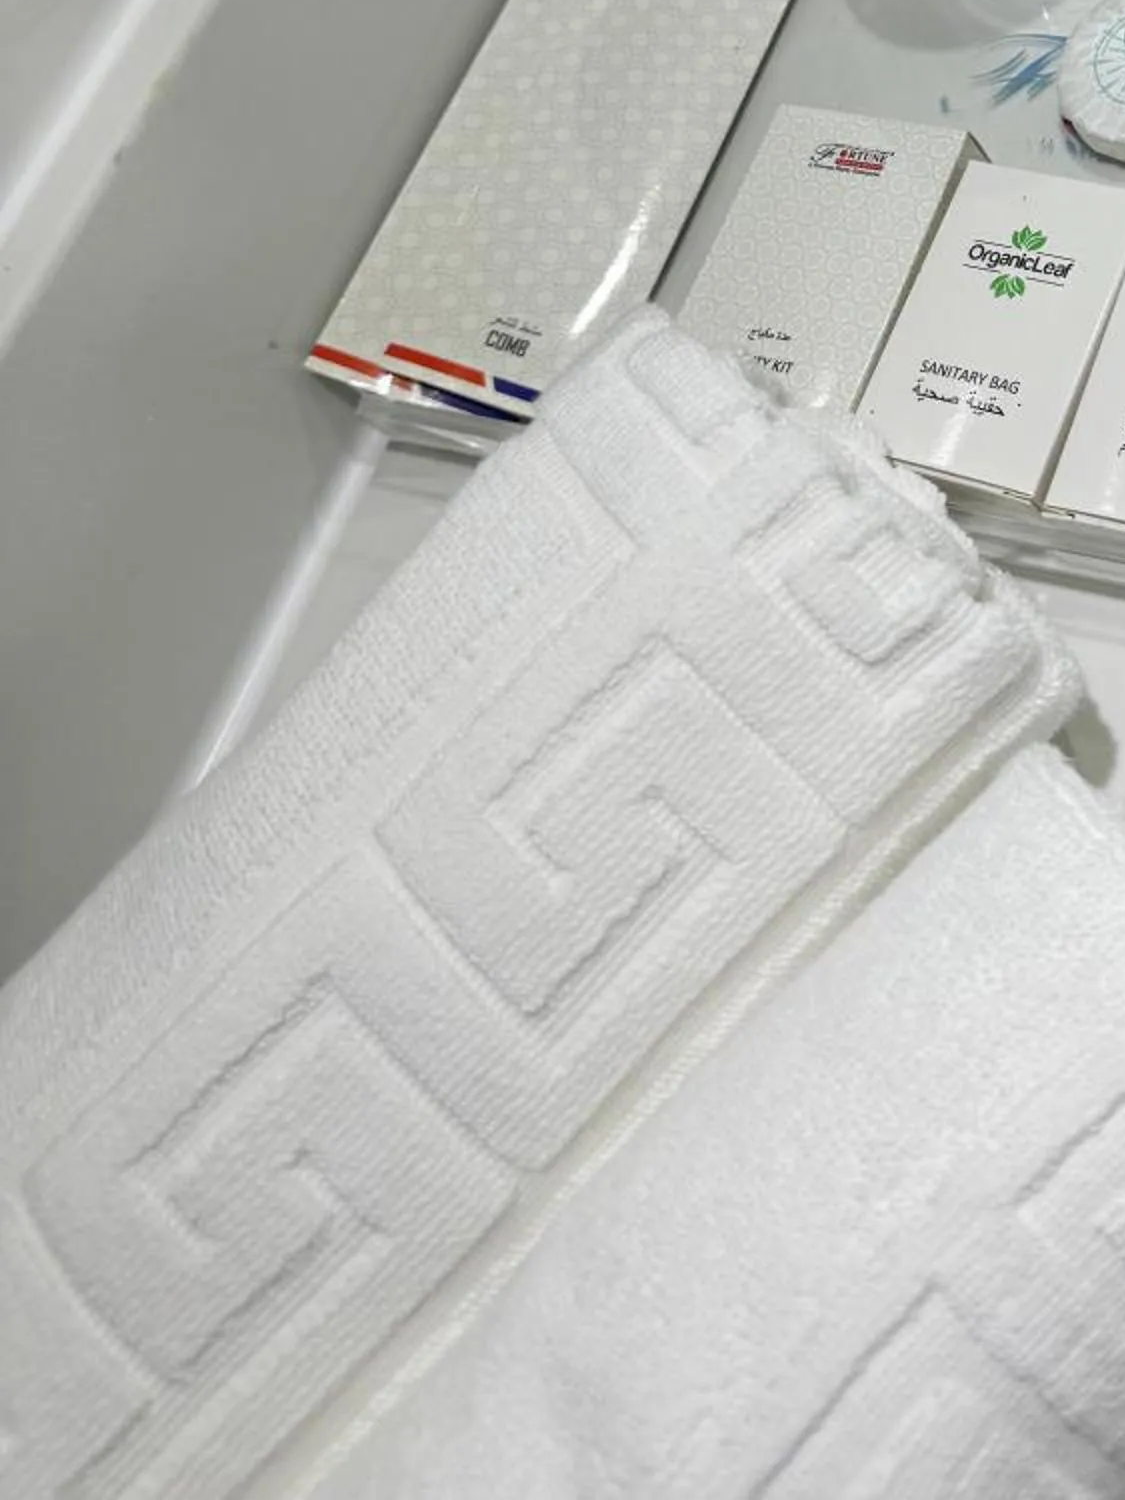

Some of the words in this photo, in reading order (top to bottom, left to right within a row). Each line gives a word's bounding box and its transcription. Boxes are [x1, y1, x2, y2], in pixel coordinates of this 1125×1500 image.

[968, 243, 1075, 279] OrganicLeaf
[484, 329, 531, 357] COMB
[919, 359, 989, 385] SANITARY
[989, 375, 1021, 395] BAG
